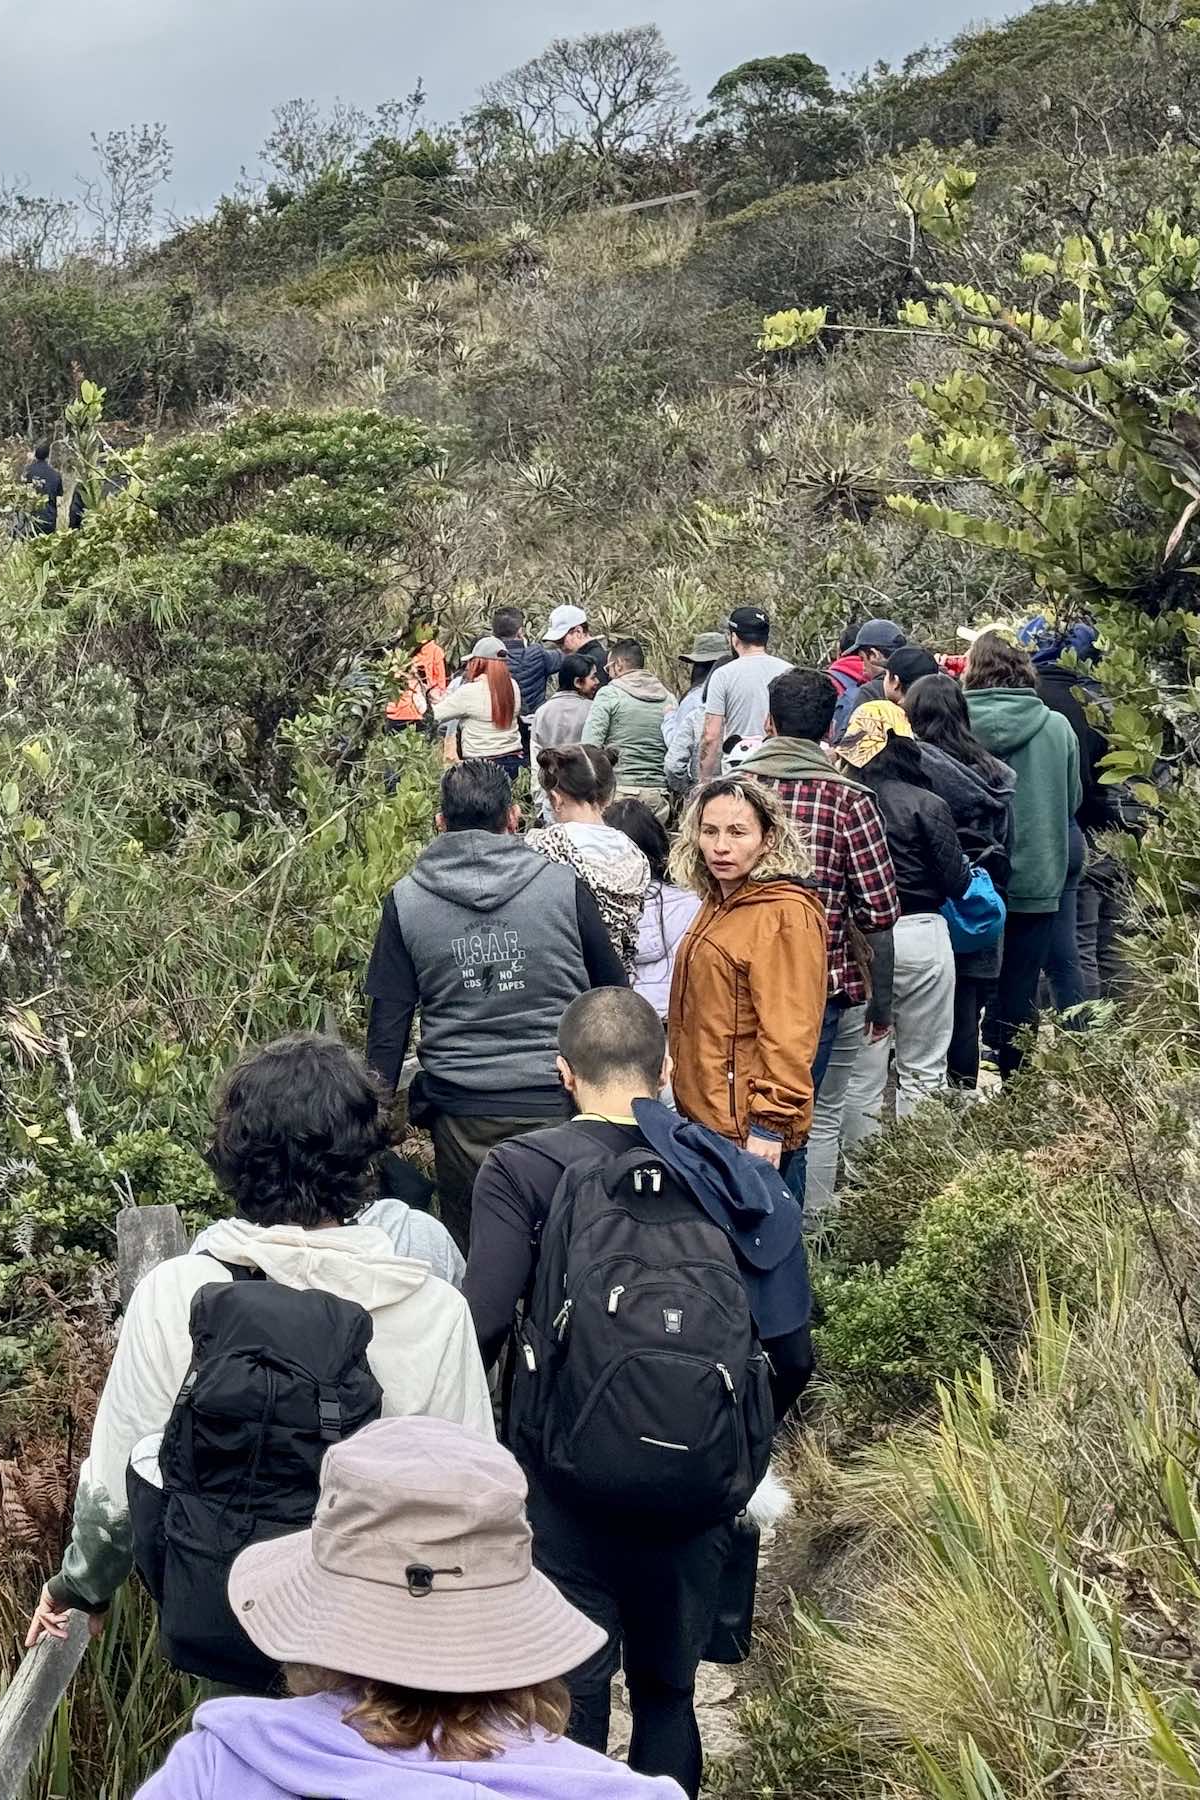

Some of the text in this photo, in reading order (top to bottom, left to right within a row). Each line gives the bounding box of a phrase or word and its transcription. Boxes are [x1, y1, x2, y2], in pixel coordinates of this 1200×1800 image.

[462, 968, 474, 978] NO
[499, 970, 512, 979] NO
[464, 979, 482, 988] CDS
[497, 981, 525, 991] TAPES
